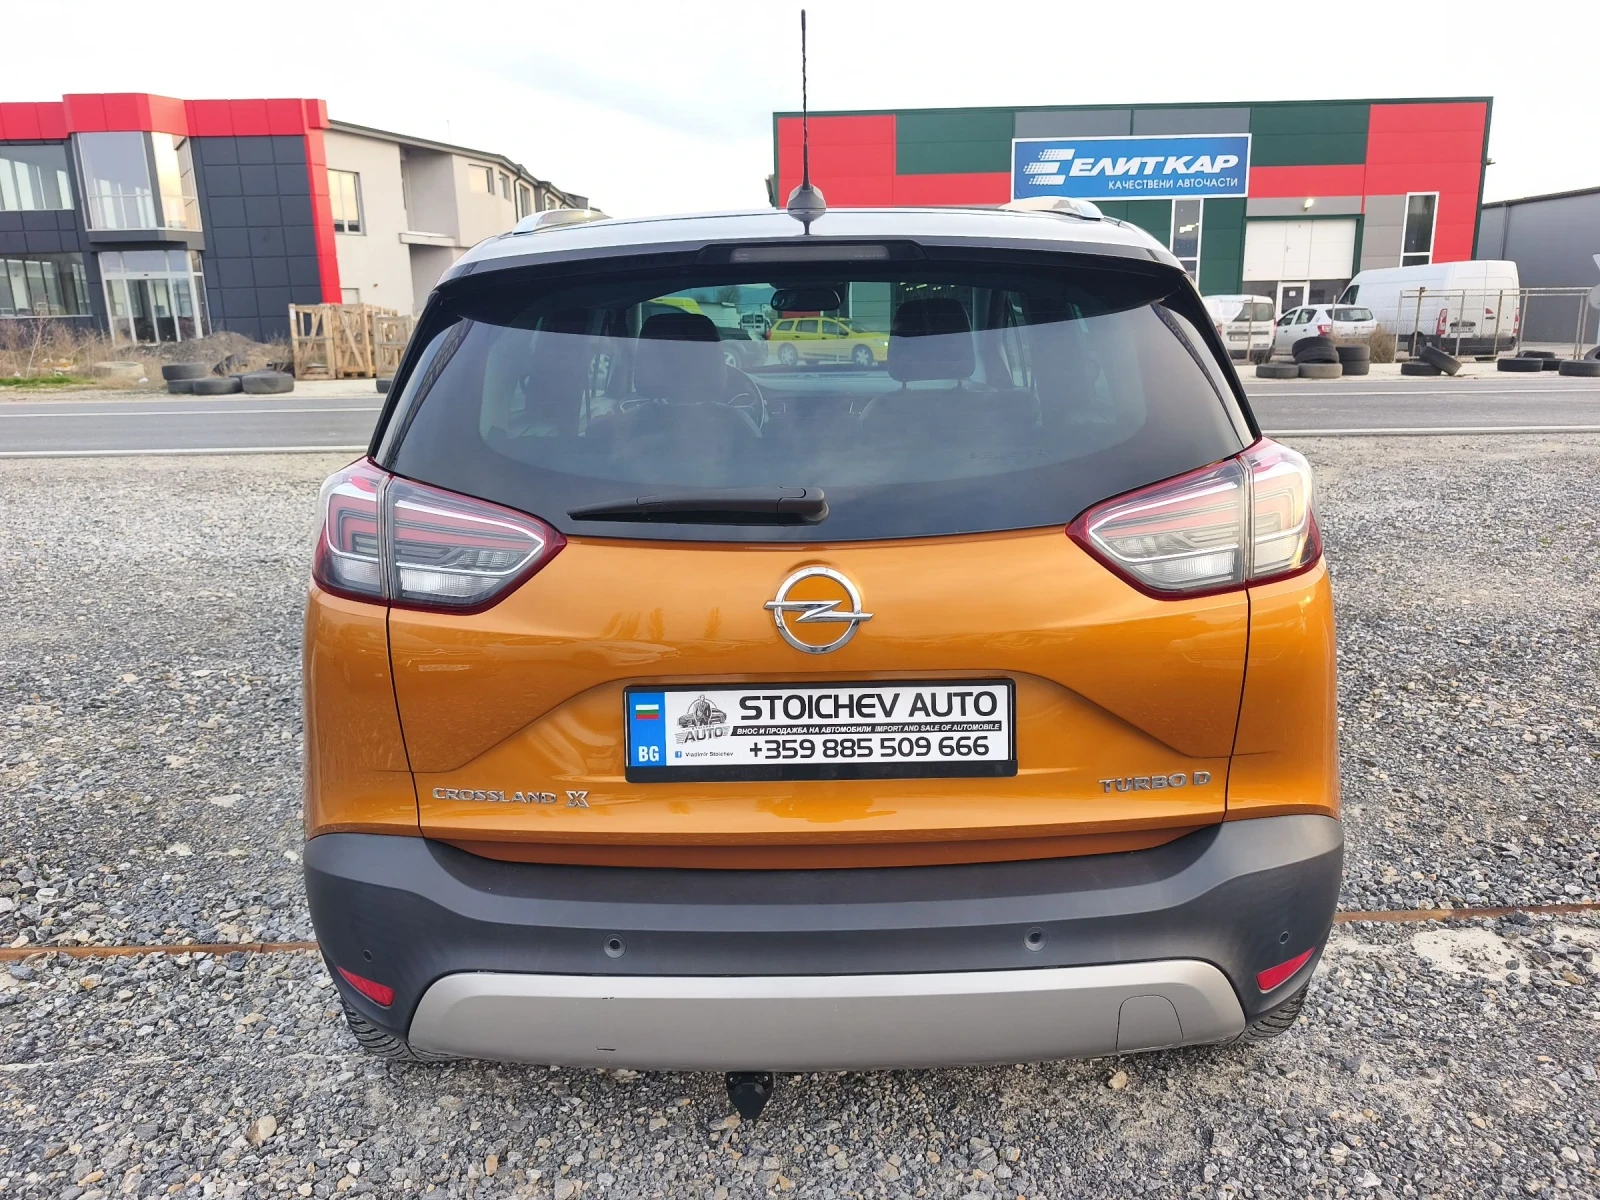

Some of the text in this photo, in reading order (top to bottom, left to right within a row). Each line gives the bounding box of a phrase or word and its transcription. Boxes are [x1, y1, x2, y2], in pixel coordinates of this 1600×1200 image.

[1108, 178, 1238, 190] КАЧЕСТВЕНИ АВТОЧАСТИ
[739, 691, 997, 720] STOICHEV AUTO
[684, 727, 723, 743] AUTO
[766, 727, 807, 735] ПРОДАЖБА
[952, 723, 1000, 731] AUTOMOBILE
[638, 746, 659, 762] BG
[750, 736, 989, 760] +359 885 509 666
[1099, 771, 1211, 793] TURBO D
[432, 787, 590, 808] CROSSLAND X
